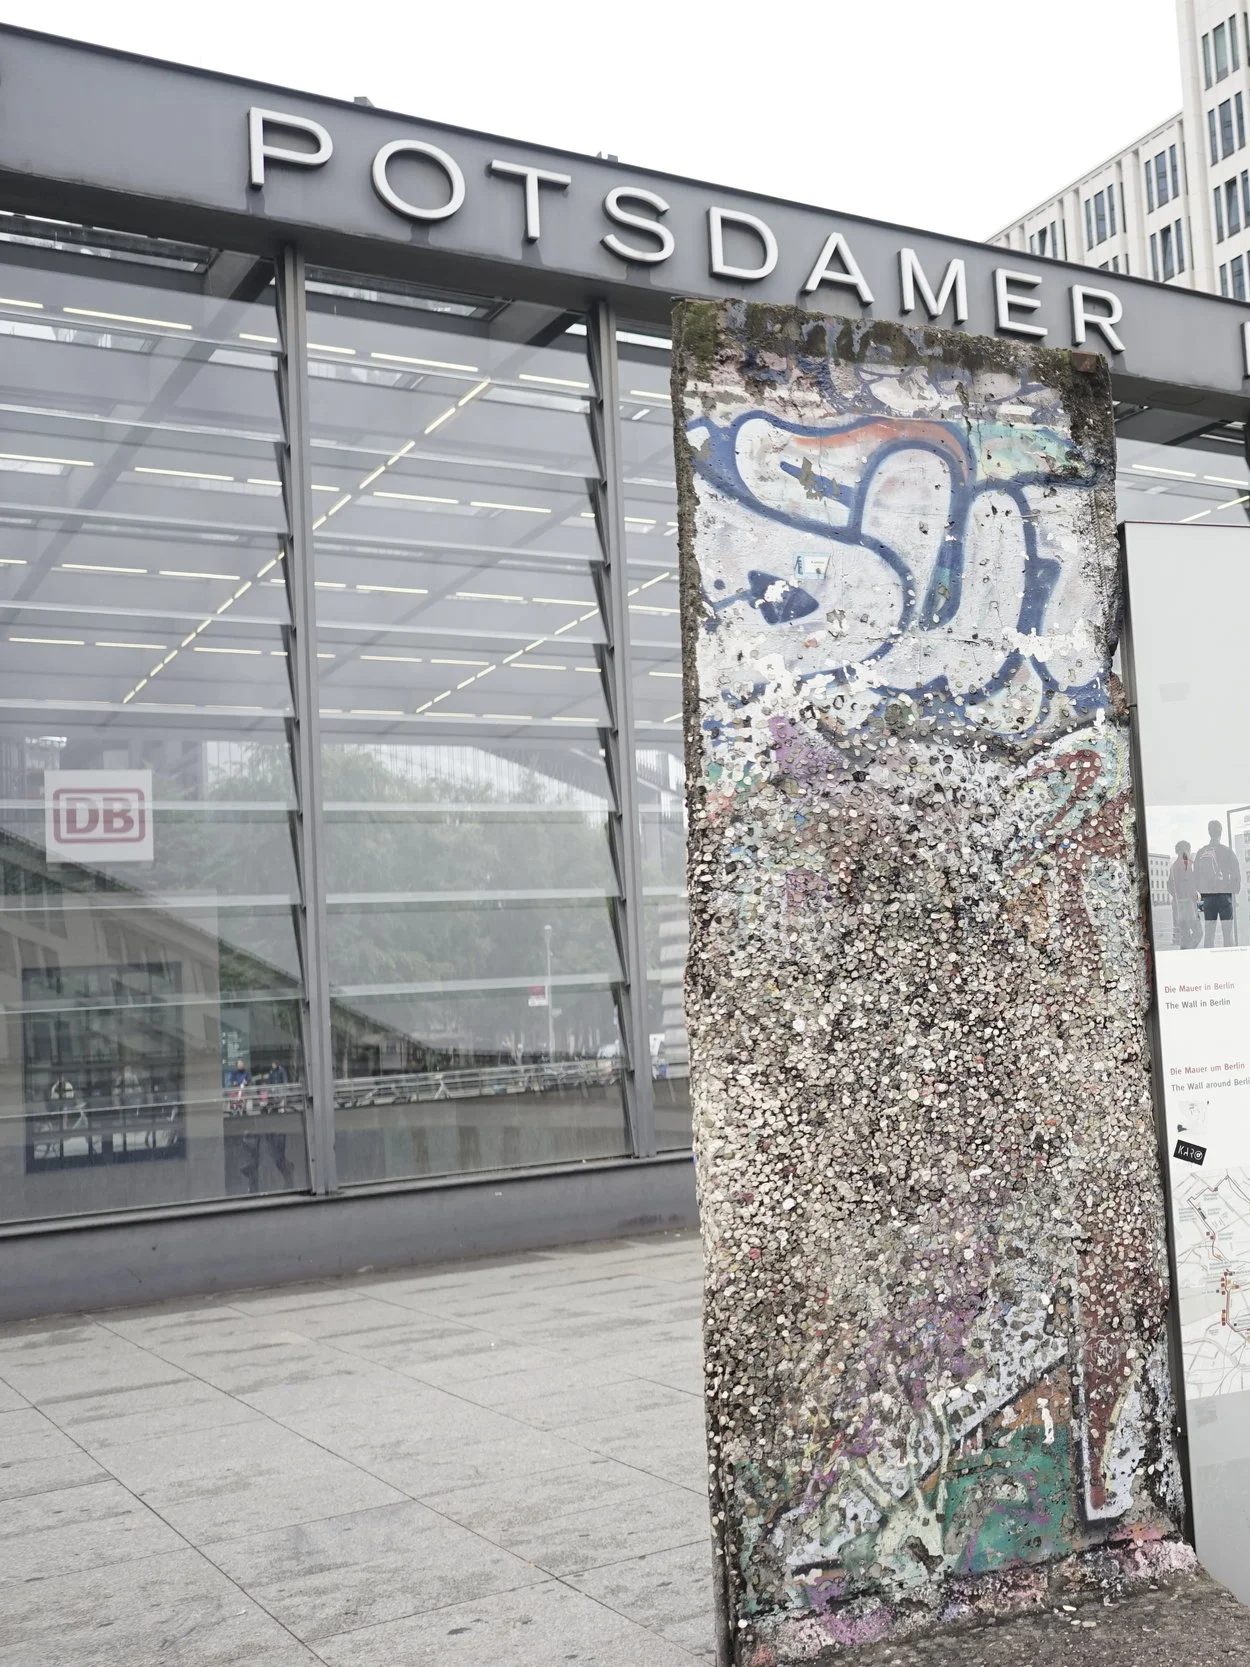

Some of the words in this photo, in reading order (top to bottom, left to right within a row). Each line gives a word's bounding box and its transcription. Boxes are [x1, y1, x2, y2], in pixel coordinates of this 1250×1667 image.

[246, 106, 1126, 353] POTSDAMER
[64, 796, 135, 835] DB
[1214, 982, 1235, 990] Berlin
[1181, 1000, 1198, 1008] Wall
[1209, 998, 1231, 1006] Berlin
[1185, 1066, 1207, 1074] Mauer
[1224, 1062, 1245, 1071] Berlin
[1187, 1082, 1203, 1091] Wall
[1206, 1080, 1231, 1089] around
